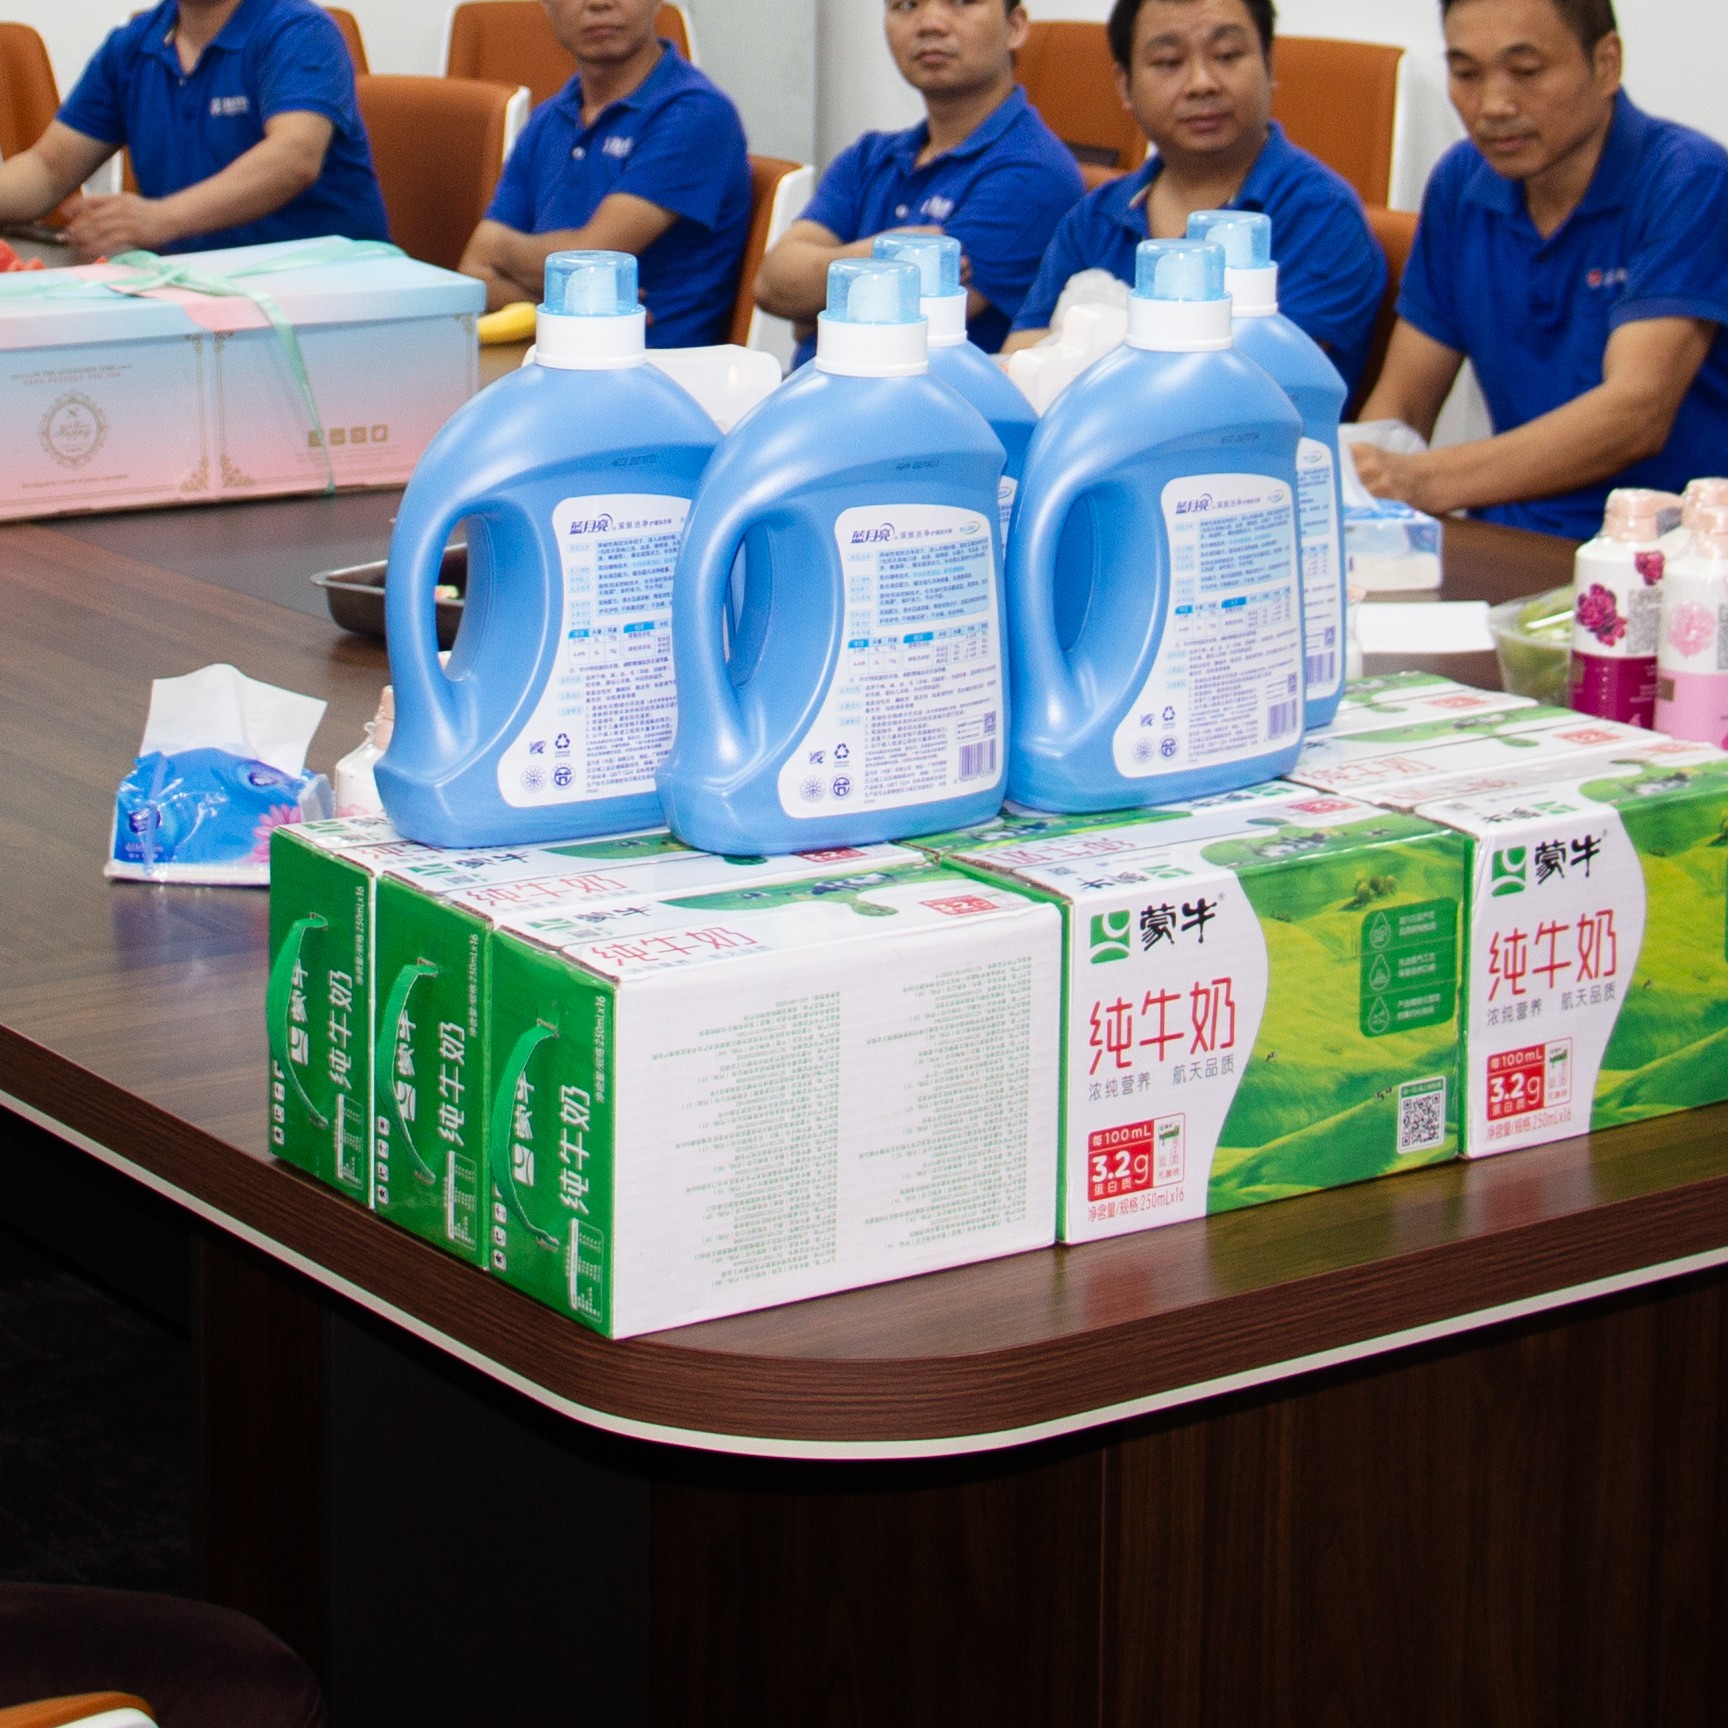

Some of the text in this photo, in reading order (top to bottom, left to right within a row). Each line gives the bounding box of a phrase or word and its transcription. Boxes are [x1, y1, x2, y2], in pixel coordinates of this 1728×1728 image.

[1535, 834, 1602, 885] 蒙牛
[467, 874, 628, 907] 纯牛奶
[592, 926, 759, 967] 纯牛奶
[1139, 897, 1218, 952] 蒙牛
[1488, 909, 1617, 1002] 纯牛奶
[328, 969, 353, 1091] 纯牛奶
[1089, 976, 1236, 1076] 纯牛奶
[438, 1021, 466, 1148] 纯牛奶
[1089, 1053, 1235, 1102] 浓纯营养 航天品质
[1490, 1071, 1541, 1106] 3.2g
[560, 1084, 590, 1215] 纯牛奶
[1091, 1150, 1149, 1185] 3.2g
